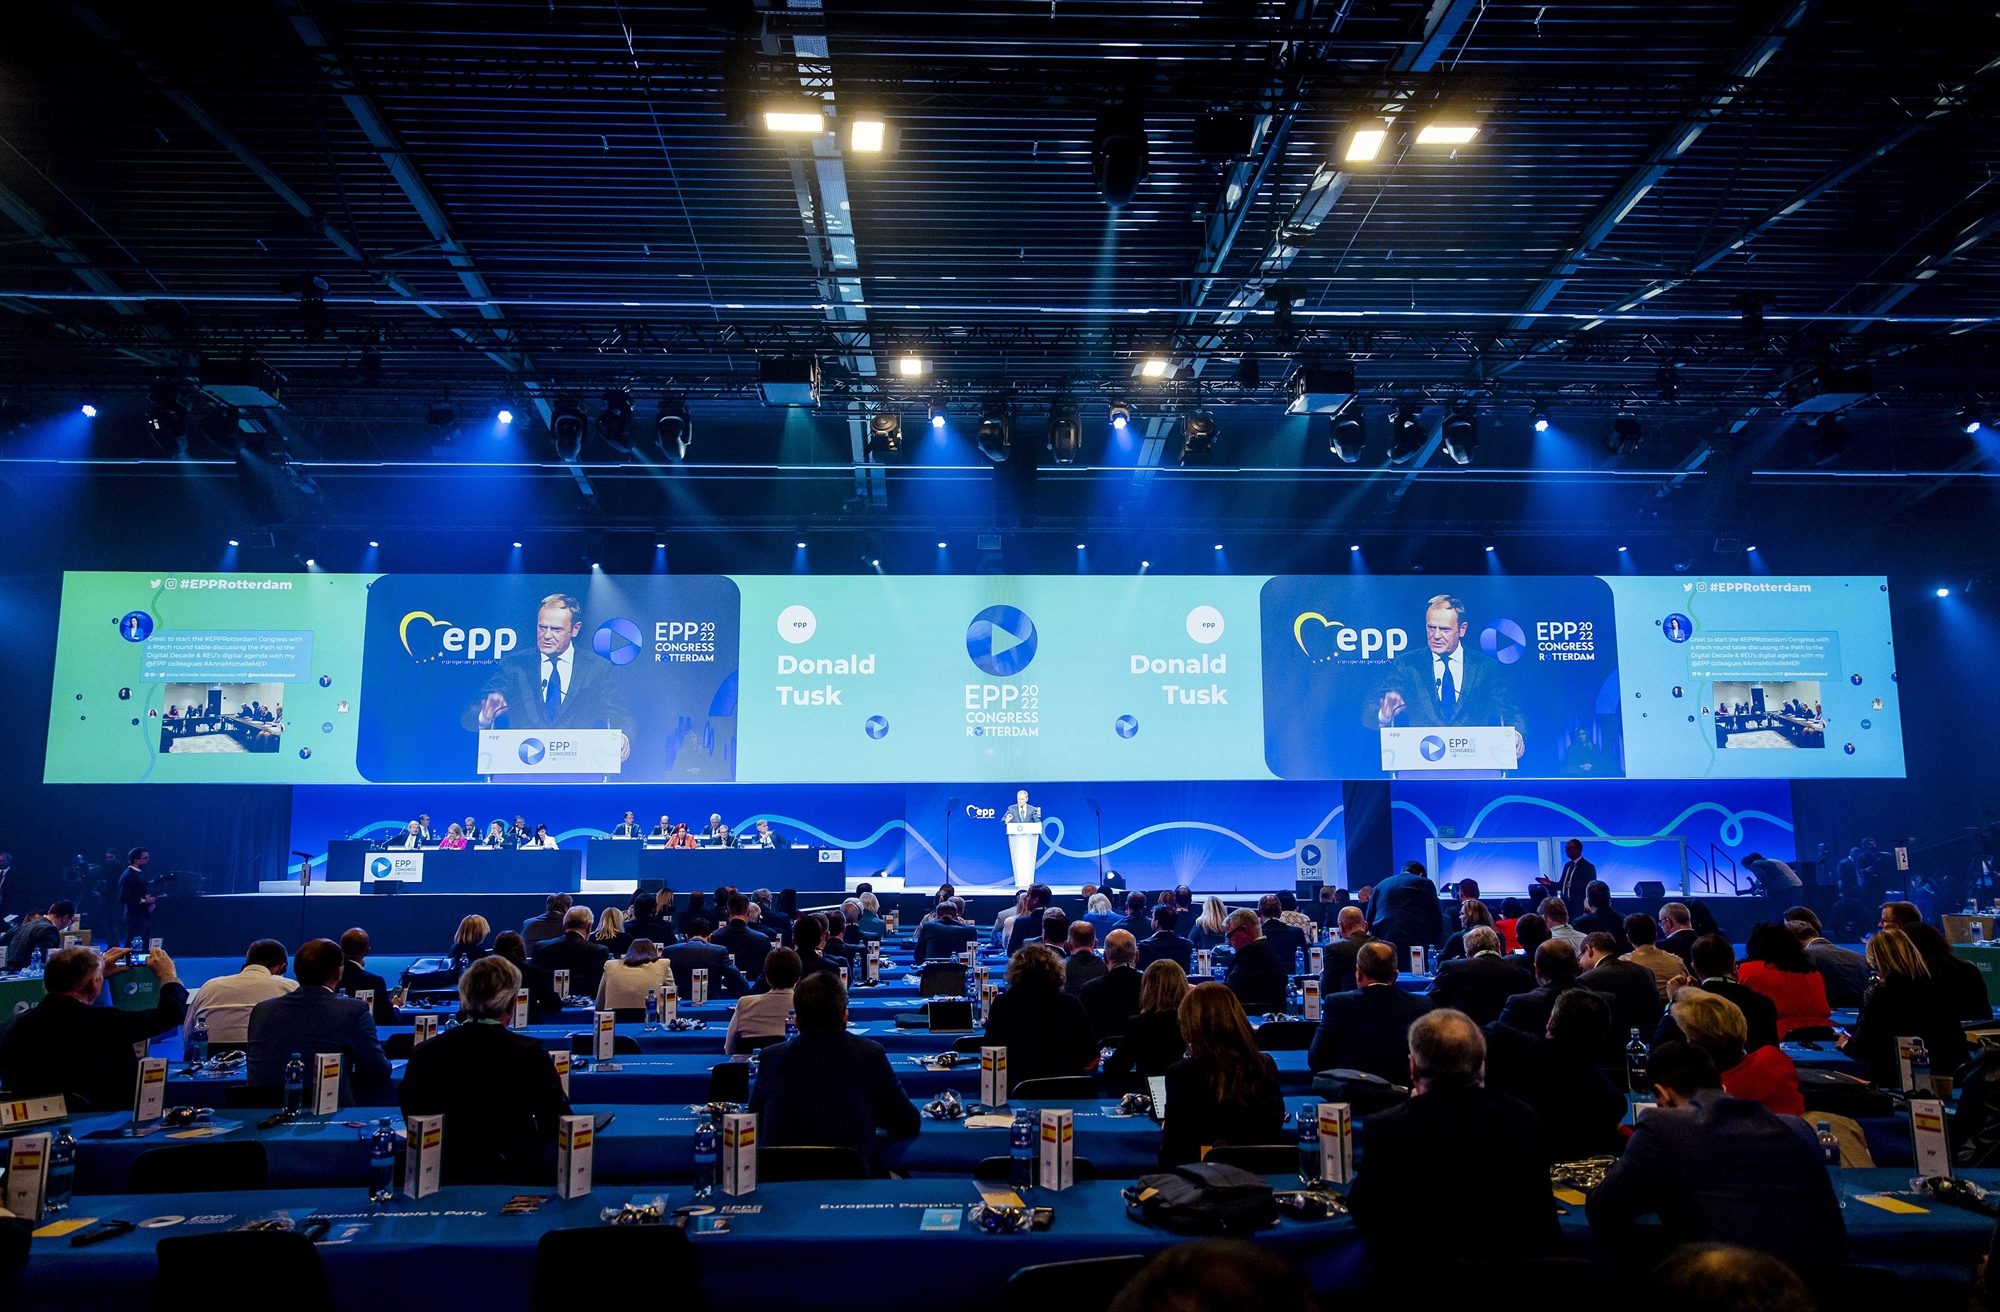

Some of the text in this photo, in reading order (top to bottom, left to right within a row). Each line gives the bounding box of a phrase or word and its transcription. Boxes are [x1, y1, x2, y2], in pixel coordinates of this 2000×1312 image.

[180, 579, 292, 590] #EPPRotterdam
[1710, 582, 1811, 592] #EPPRotterdam
[700, 622, 715, 632] 20
[1536, 621, 1578, 641] EPP
[1578, 621, 1593, 631] 20
[655, 622, 699, 641] EPP
[699, 631, 715, 641] 22
[1579, 631, 1594, 640] 22
[443, 627, 517, 659] epp
[655, 642, 715, 652] CONGRESS
[1336, 628, 1408, 659] epp
[1538, 642, 1595, 651] CONGRESS
[655, 653, 714, 662] ROTTERDAM
[1539, 652, 1595, 661] ROTTERDAM
[777, 654, 875, 675] Donald
[1130, 653, 1226, 674] Donald
[775, 684, 843, 706] Tusk
[1021, 684, 1039, 696] 20
[1162, 684, 1229, 705] Tusk
[965, 684, 1019, 709] EPP
[1021, 697, 1039, 709] 22
[965, 711, 1039, 723] CONGRESS
[966, 726, 1039, 737] ROTTERDAM
[549, 741, 570, 751] EPP
[1449, 738, 1468, 748] EPP
[976, 808, 995, 817] epp
[1901, 853, 1906, 863] 2
[395, 859, 411, 868] EPP
[1301, 868, 1316, 876] EPP
